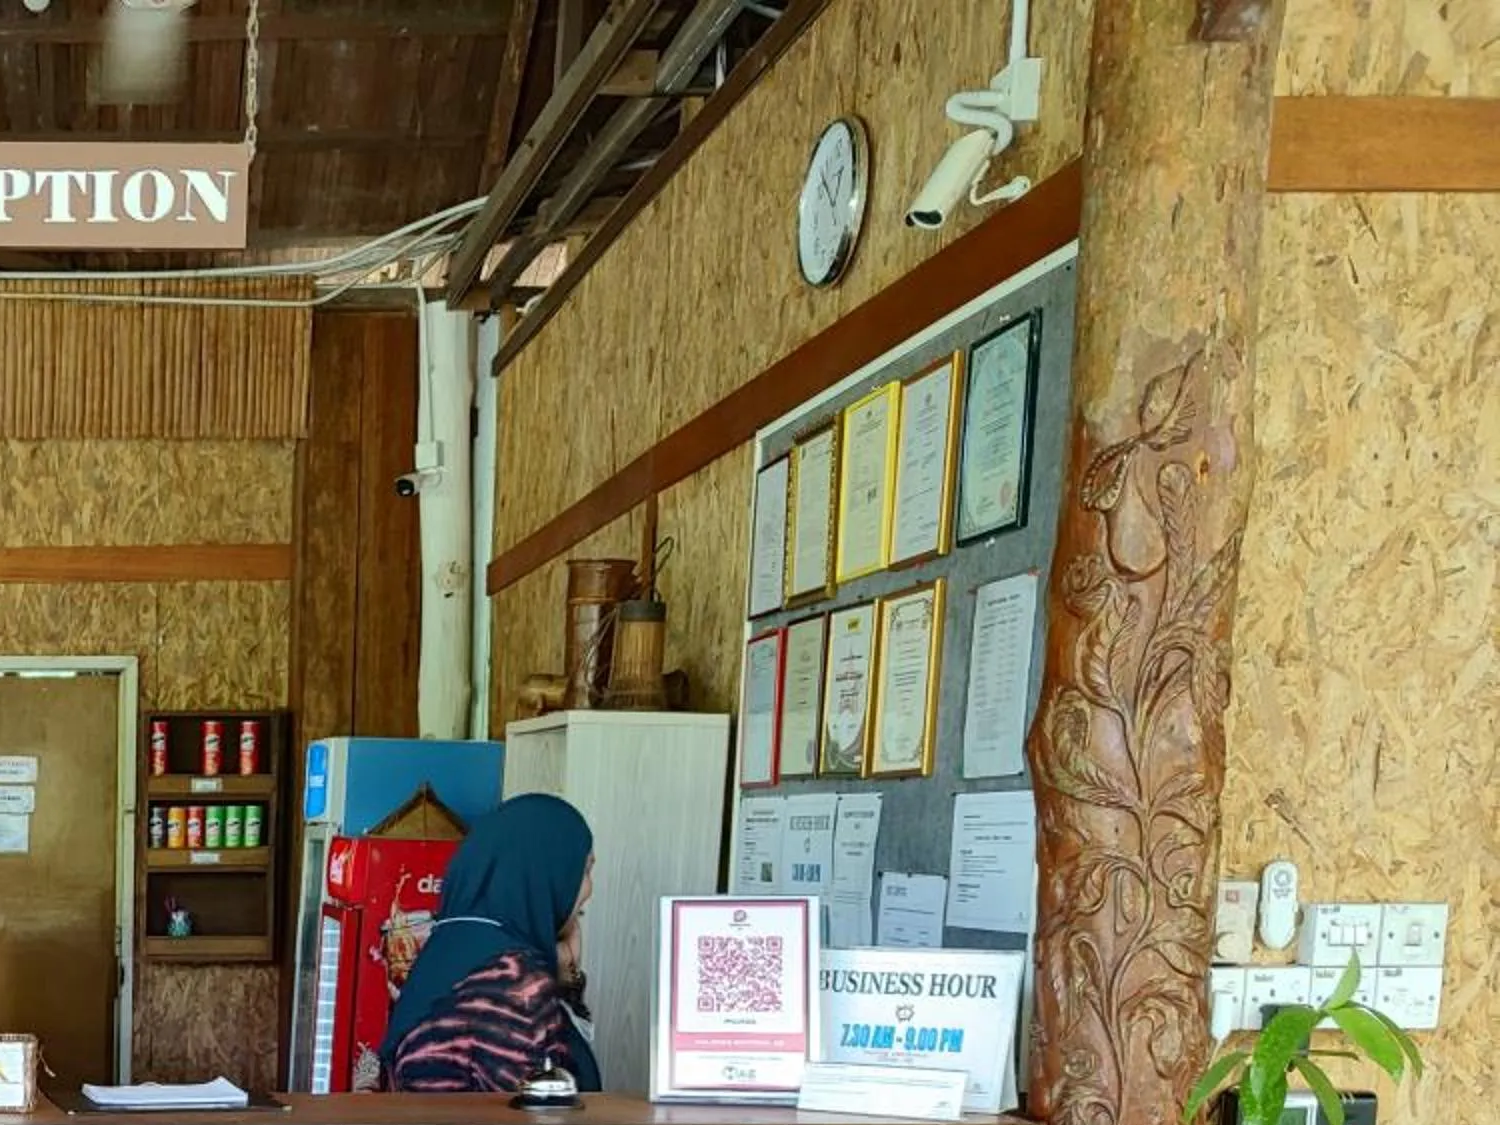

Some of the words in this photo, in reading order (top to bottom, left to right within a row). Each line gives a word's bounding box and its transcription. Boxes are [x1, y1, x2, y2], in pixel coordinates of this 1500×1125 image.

[820, 969, 924, 996] BUSINESS
[928, 973, 998, 998] HOUR
[938, 1028, 965, 1053] PM
